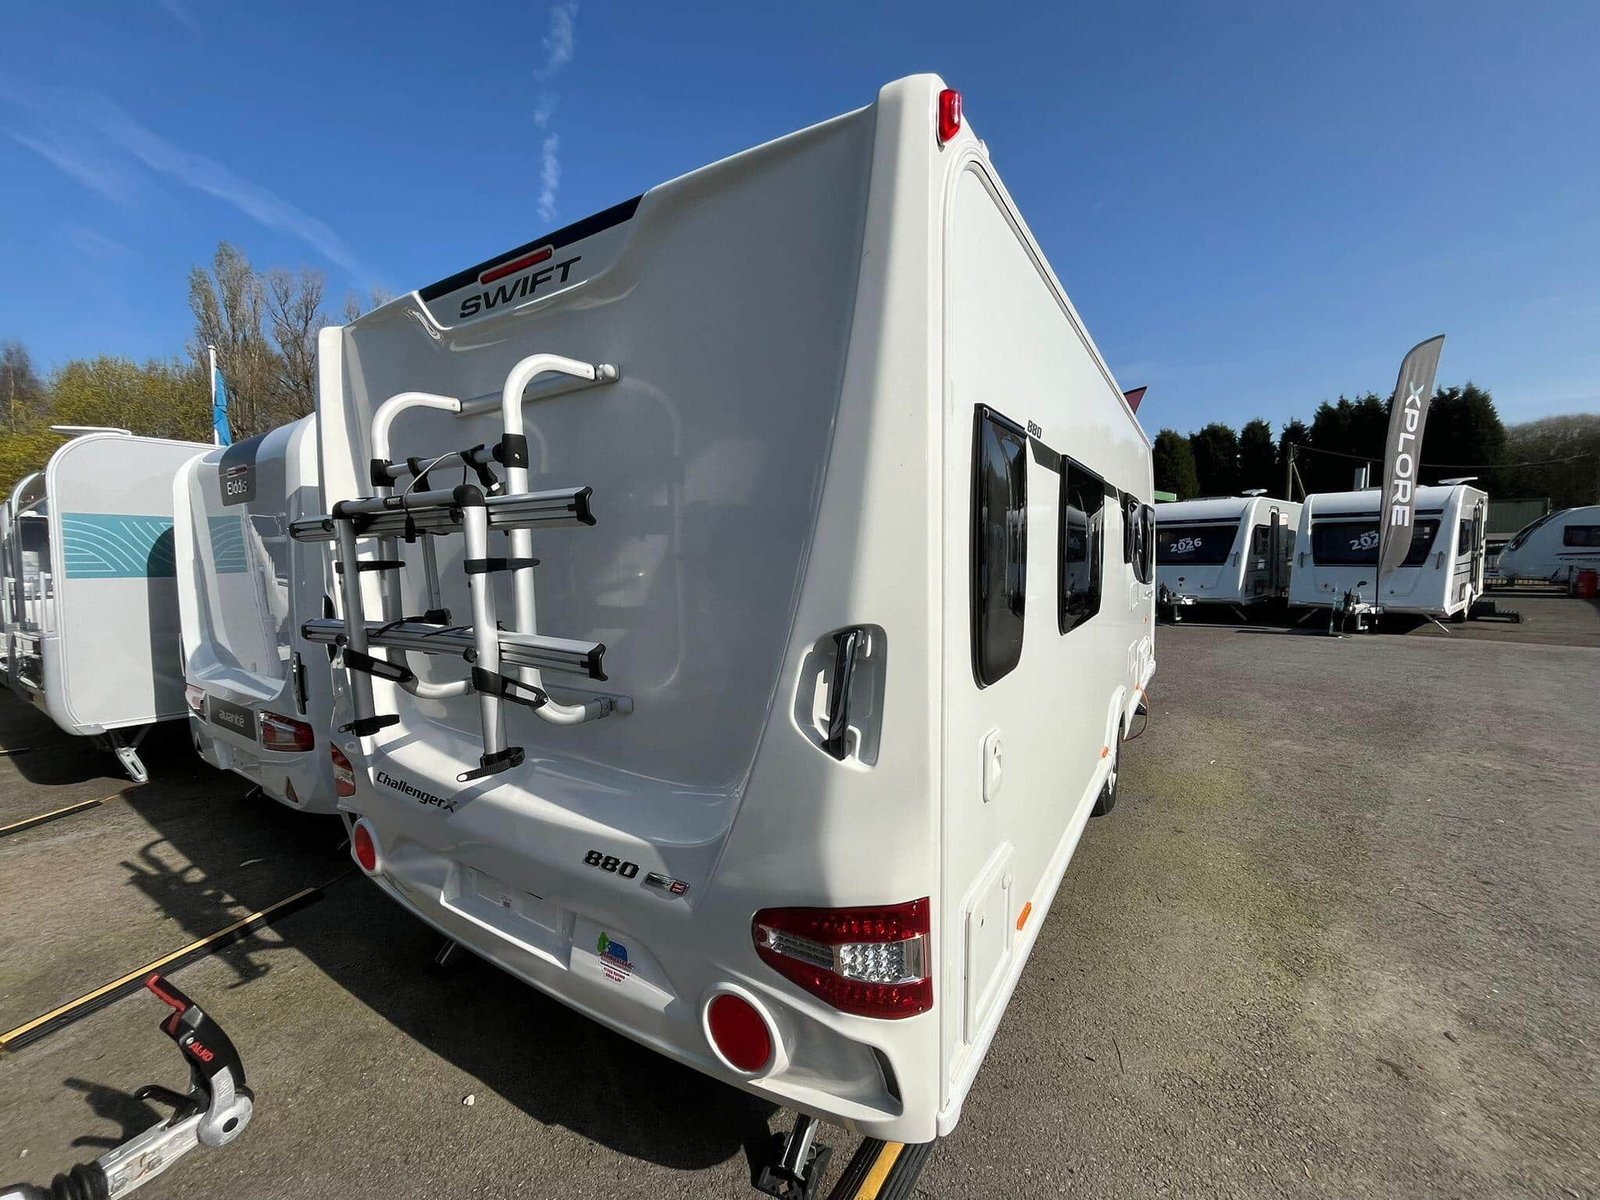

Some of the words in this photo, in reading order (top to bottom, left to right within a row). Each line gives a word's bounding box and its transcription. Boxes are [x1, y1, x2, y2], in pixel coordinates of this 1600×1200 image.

[459, 256, 581, 318] SWIFT
[1027, 419, 1043, 439] 880
[1391, 381, 1425, 526] XPLORE
[1170, 537, 1202, 552] 2026
[1349, 533, 1379, 550] 202
[584, 849, 640, 879] 880
